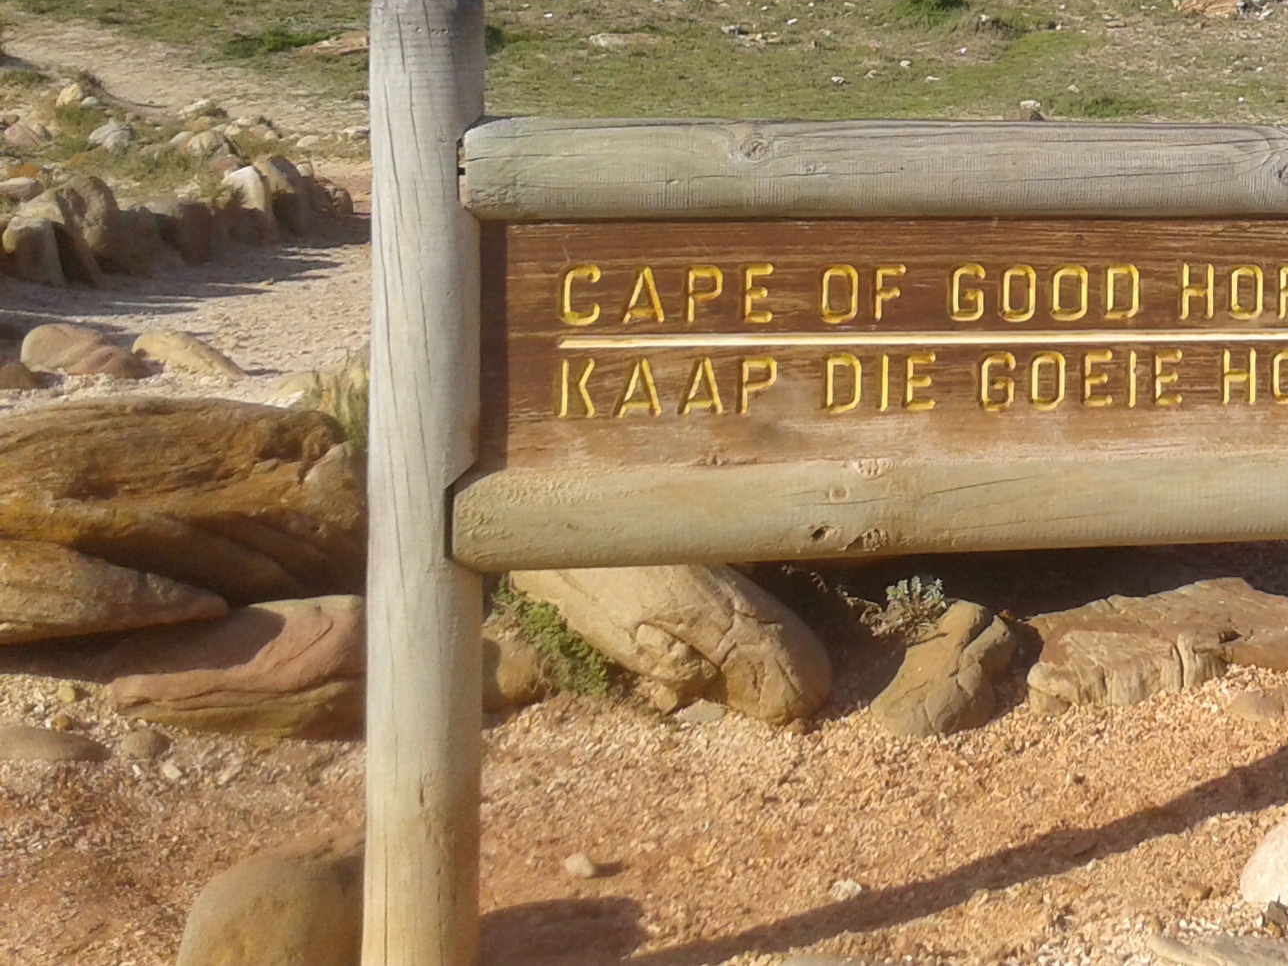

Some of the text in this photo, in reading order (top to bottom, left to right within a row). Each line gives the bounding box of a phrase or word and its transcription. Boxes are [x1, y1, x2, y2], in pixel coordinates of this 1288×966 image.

[562, 264, 774, 326] CAPE
[819, 263, 907, 325] OF
[948, 263, 1141, 322] GOOD
[556, 356, 779, 418] KAAP
[823, 351, 937, 414] DIE
[978, 349, 1184, 412] GOEIE
